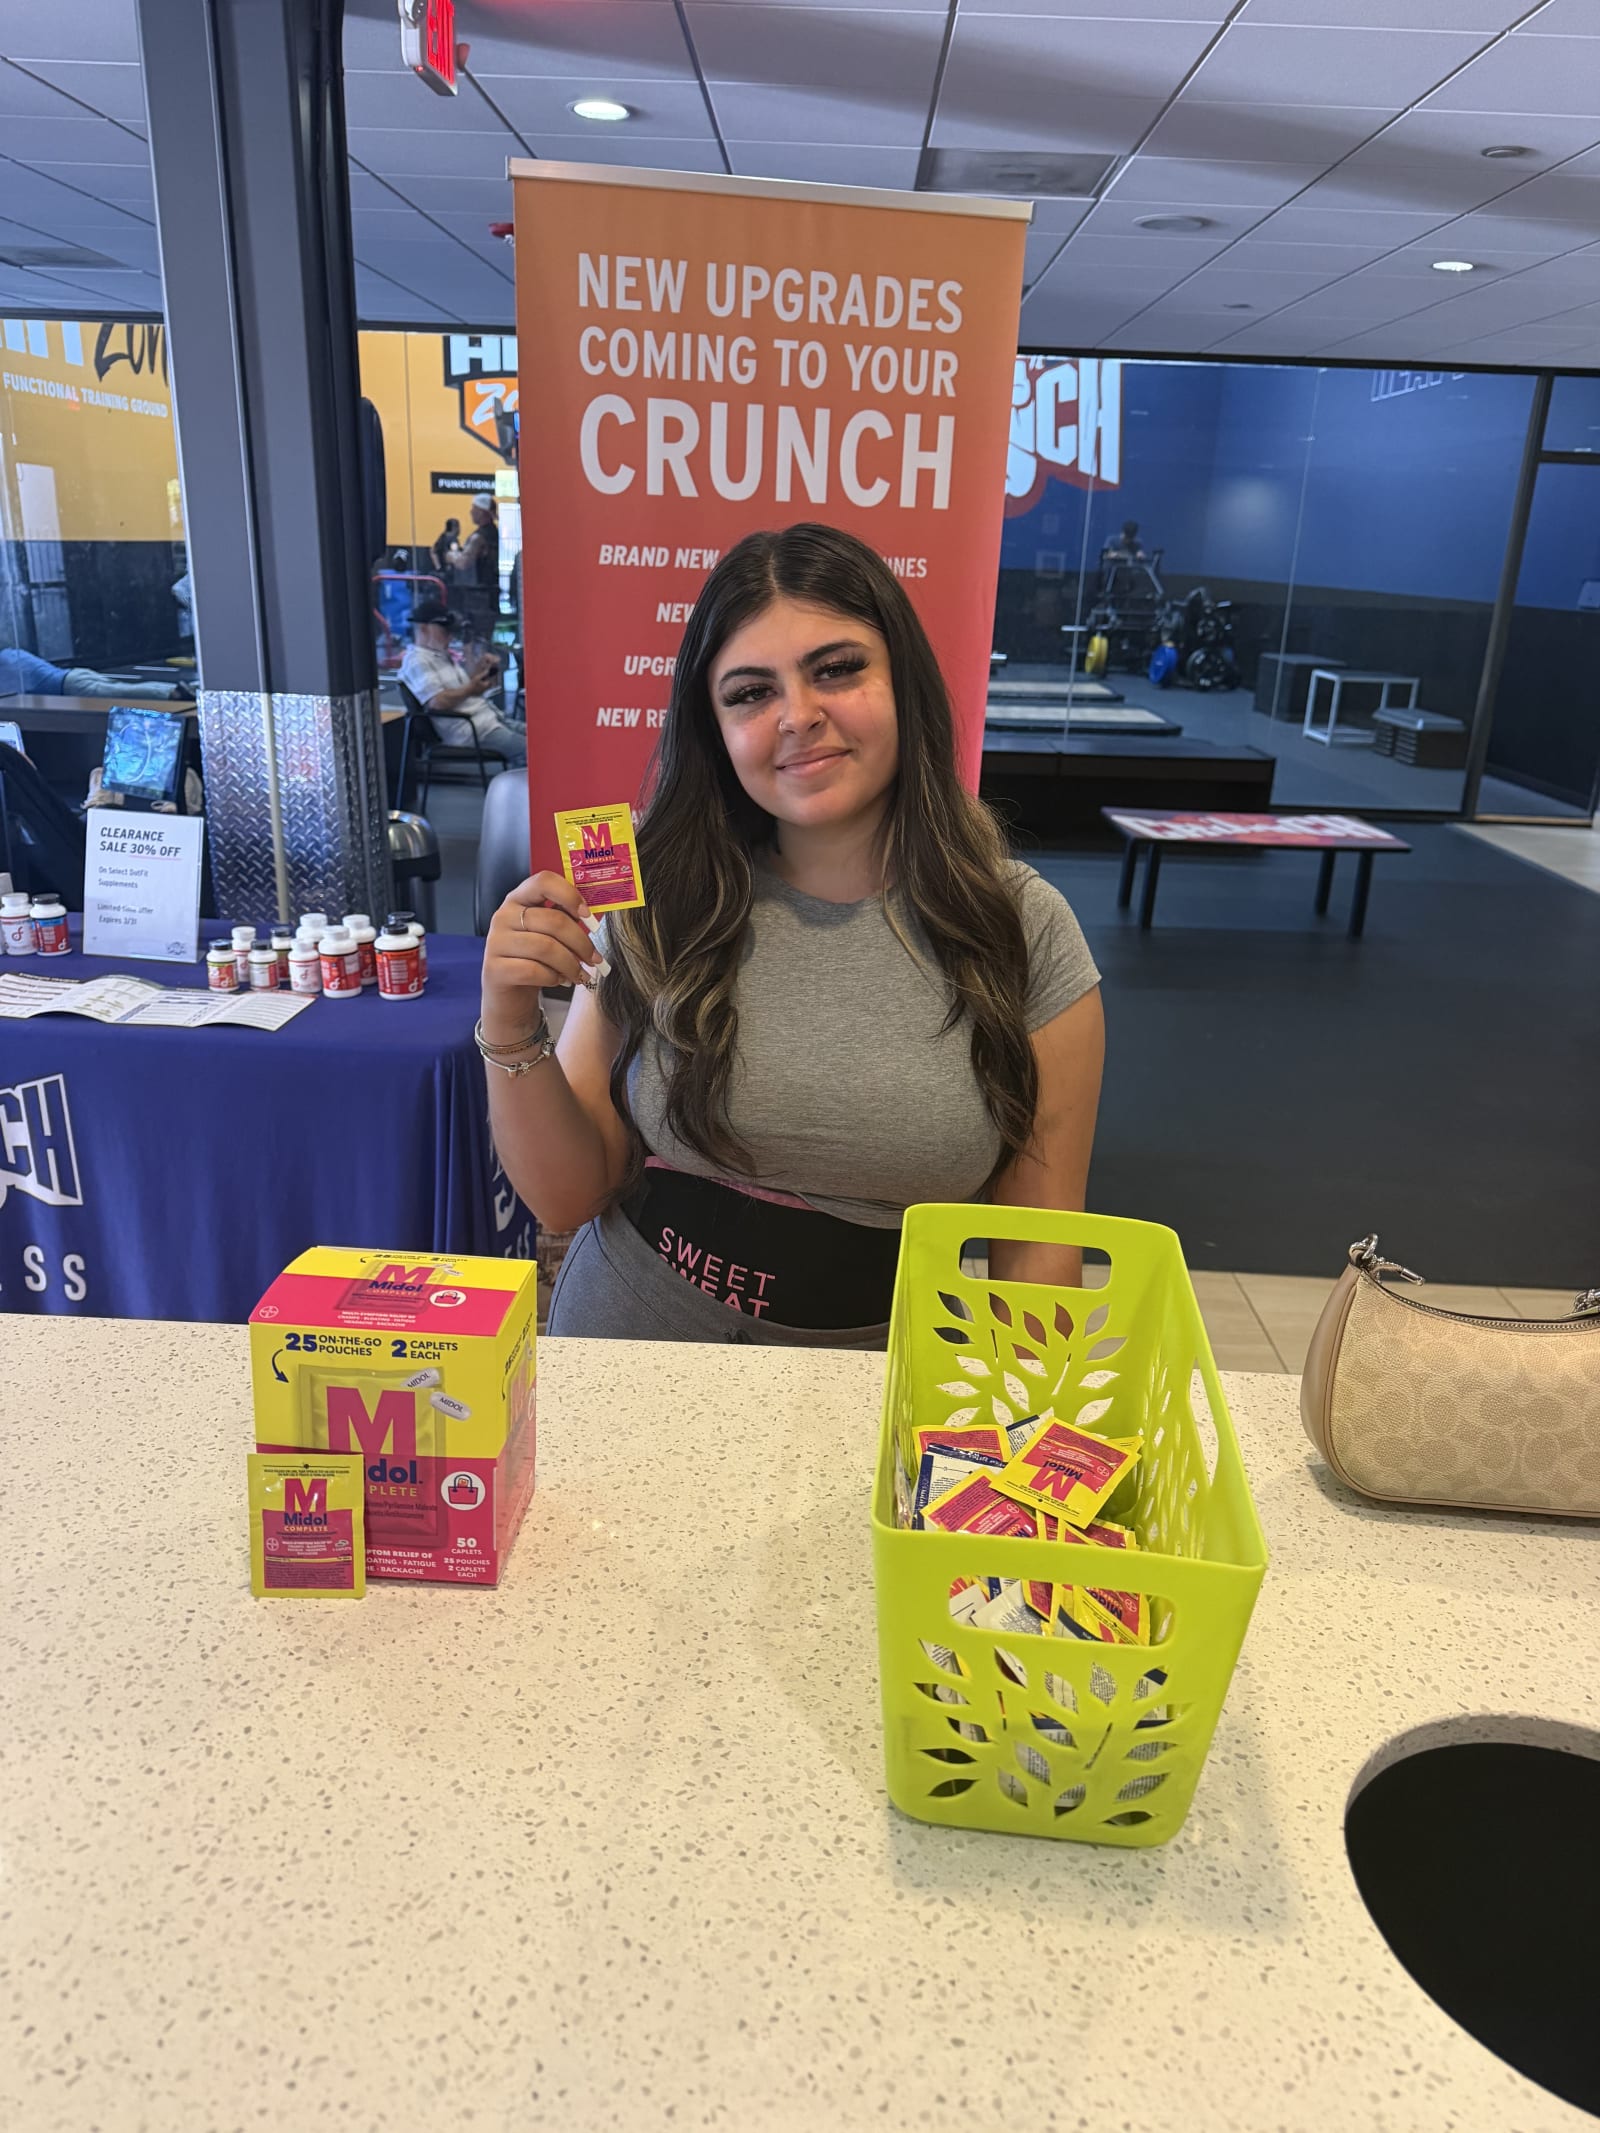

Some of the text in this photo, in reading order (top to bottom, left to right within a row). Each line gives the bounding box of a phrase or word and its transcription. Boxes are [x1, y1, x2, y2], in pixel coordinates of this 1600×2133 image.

[578, 252, 963, 334] NEW UPGRADES
[579, 325, 958, 398] COMING TO YOUR
[3, 371, 168, 418] FUNCTIONAL TRAINING GROUND
[579, 393, 955, 510] CRUNCH
[598, 544, 928, 578] BRAND NEW INES
[596, 707, 641, 728] NEW
[100, 827, 165, 842] CLEARANCE
[99, 840, 181, 857] SALE 30% OFF
[584, 847, 614, 859] Midol
[658, 1226, 776, 1297] SWEET
[368, 1280, 424, 1293] Midol
[658, 1253, 770, 1319] EAT
[284, 1332, 318, 1352] 25
[319, 1335, 382, 1347] ON-THE-GO
[391, 1339, 408, 1358] 2
[410, 1341, 458, 1351] CAPLETS
[319, 1345, 372, 1356] POUCHES
[410, 1351, 441, 1360] EACH
[440, 1397, 464, 1413] MIDOL
[326, 1385, 417, 1456] M
[1043, 1460, 1083, 1481] Midol
[284, 1512, 328, 1526] Midol
[457, 1537, 477, 1548] 50
[393, 1550, 419, 1558] RELIEF
[456, 1558, 490, 1566] POUCHES
[381, 1566, 424, 1575] BACKACHE
[403, 1559, 437, 1568] FATIGUE
